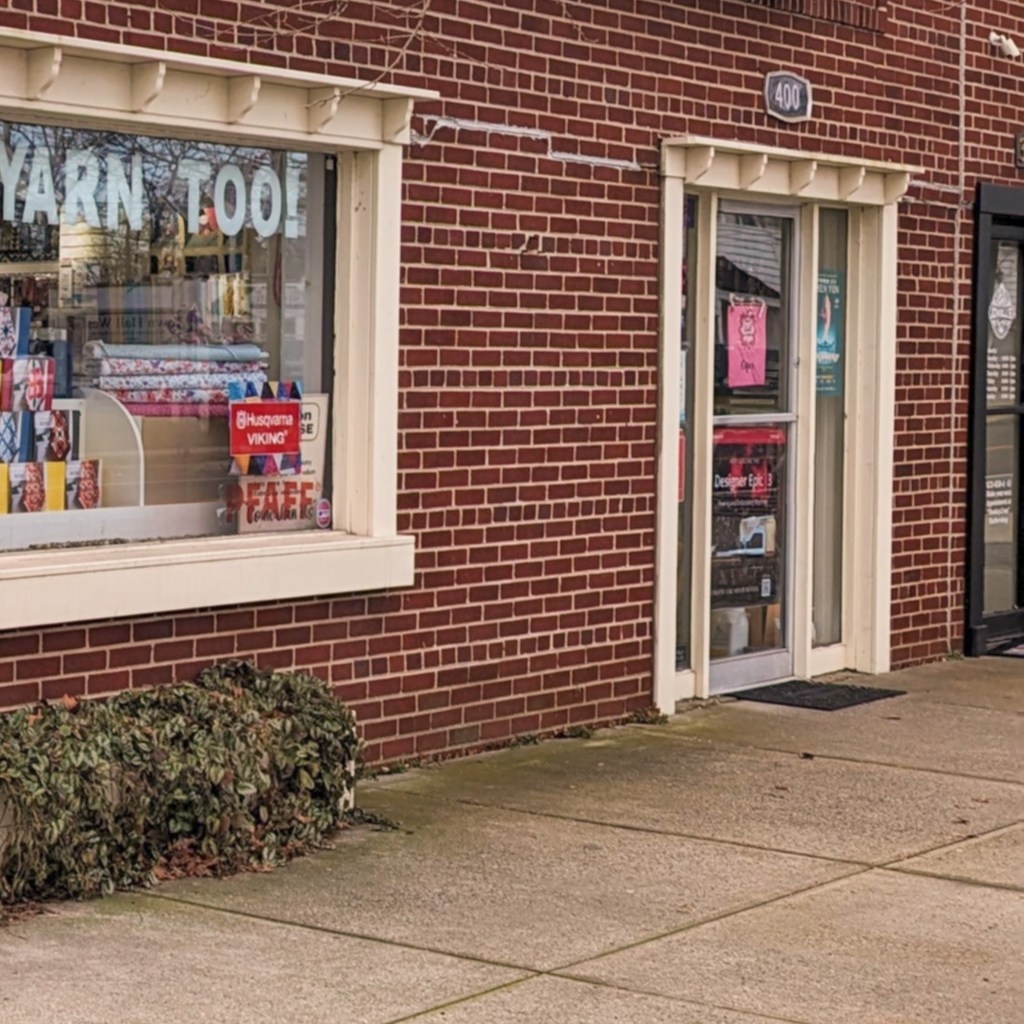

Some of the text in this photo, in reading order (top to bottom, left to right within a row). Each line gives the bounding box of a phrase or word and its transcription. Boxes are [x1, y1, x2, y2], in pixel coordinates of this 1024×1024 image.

[775, 81, 800, 111] 400
[177, 152, 306, 239] TOO!
[246, 413, 293, 427] Husqvarna
[714, 474, 748, 492] Designer
[748, 473, 763, 491] Epic
